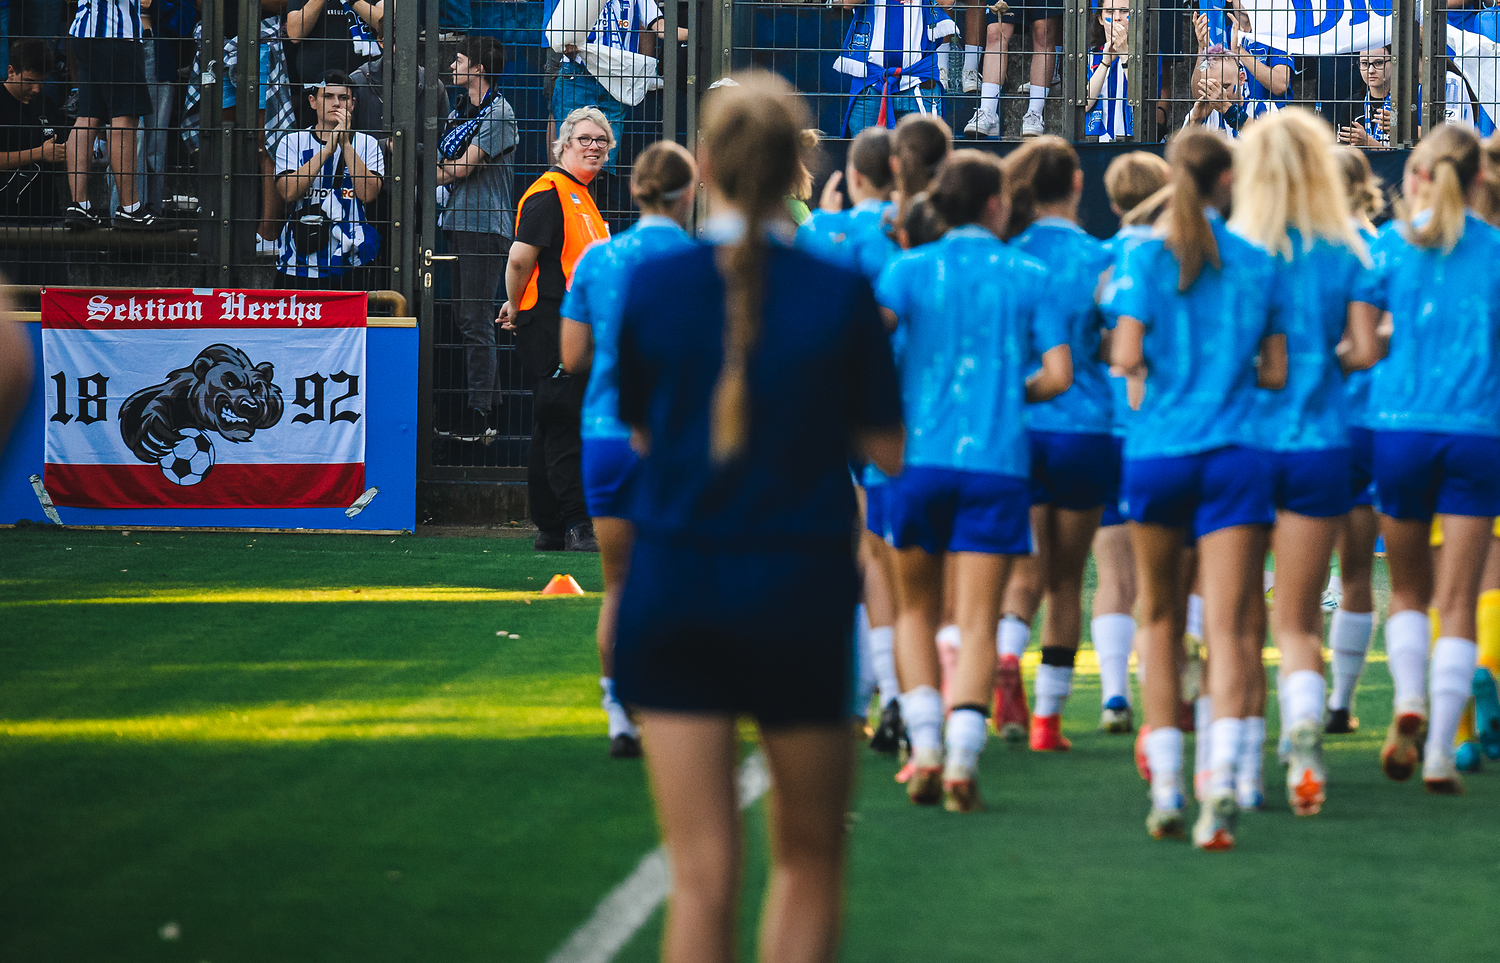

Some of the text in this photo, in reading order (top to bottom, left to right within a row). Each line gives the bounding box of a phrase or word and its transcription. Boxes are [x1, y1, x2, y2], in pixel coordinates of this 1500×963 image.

[86, 292, 322, 326] Sektion Hertha
[50, 370, 362, 425] 18 92
